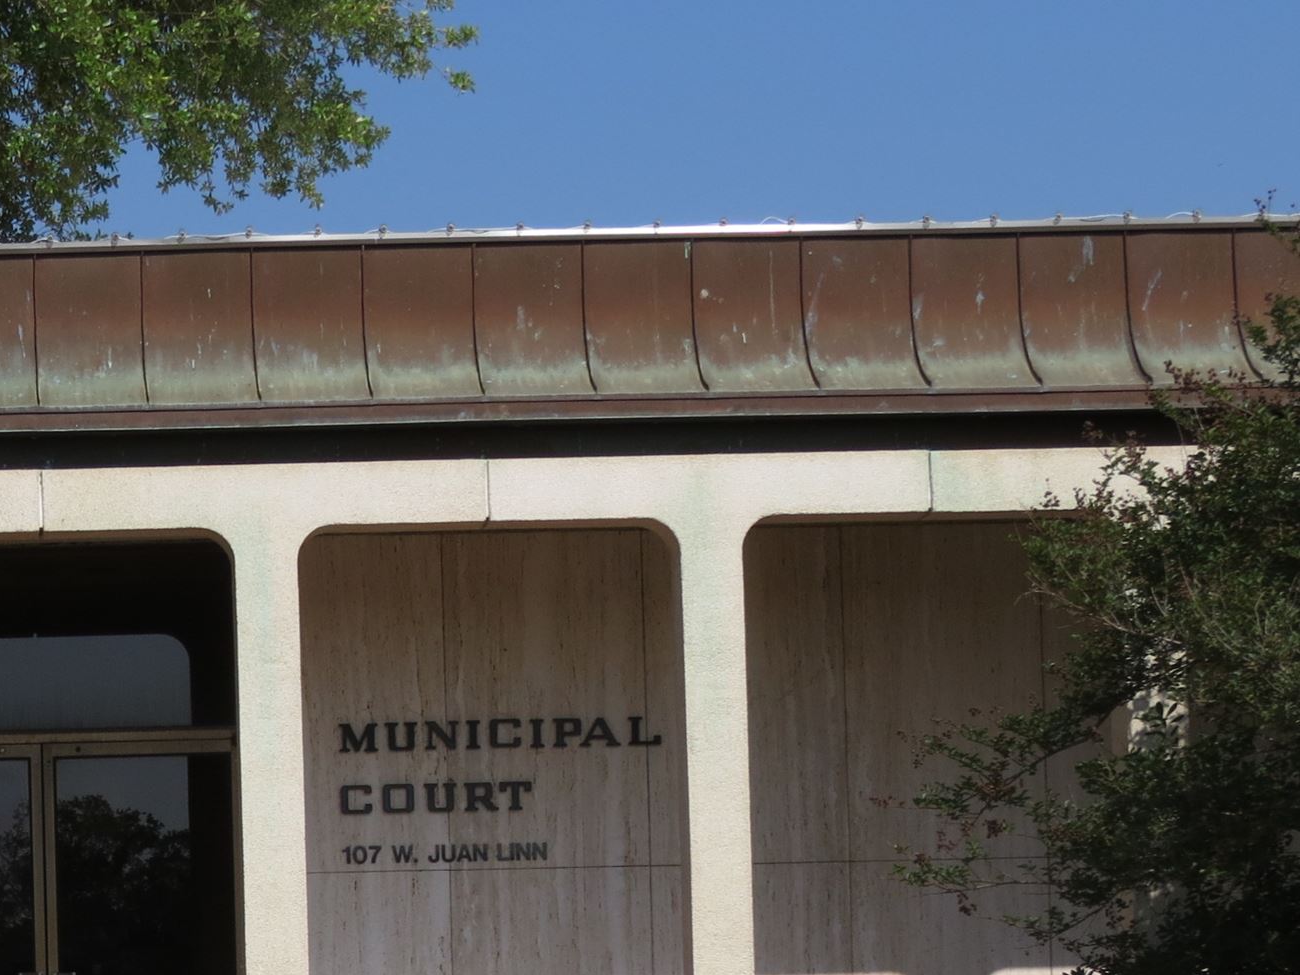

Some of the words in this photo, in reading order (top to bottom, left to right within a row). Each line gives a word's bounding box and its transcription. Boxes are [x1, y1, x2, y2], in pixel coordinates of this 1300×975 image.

[338, 716, 662, 753] MUNICIPAL
[340, 781, 532, 815] COURT
[342, 845, 382, 865] 107
[391, 845, 418, 864] W.
[428, 843, 488, 864] JUAN
[496, 842, 548, 861] LINN
